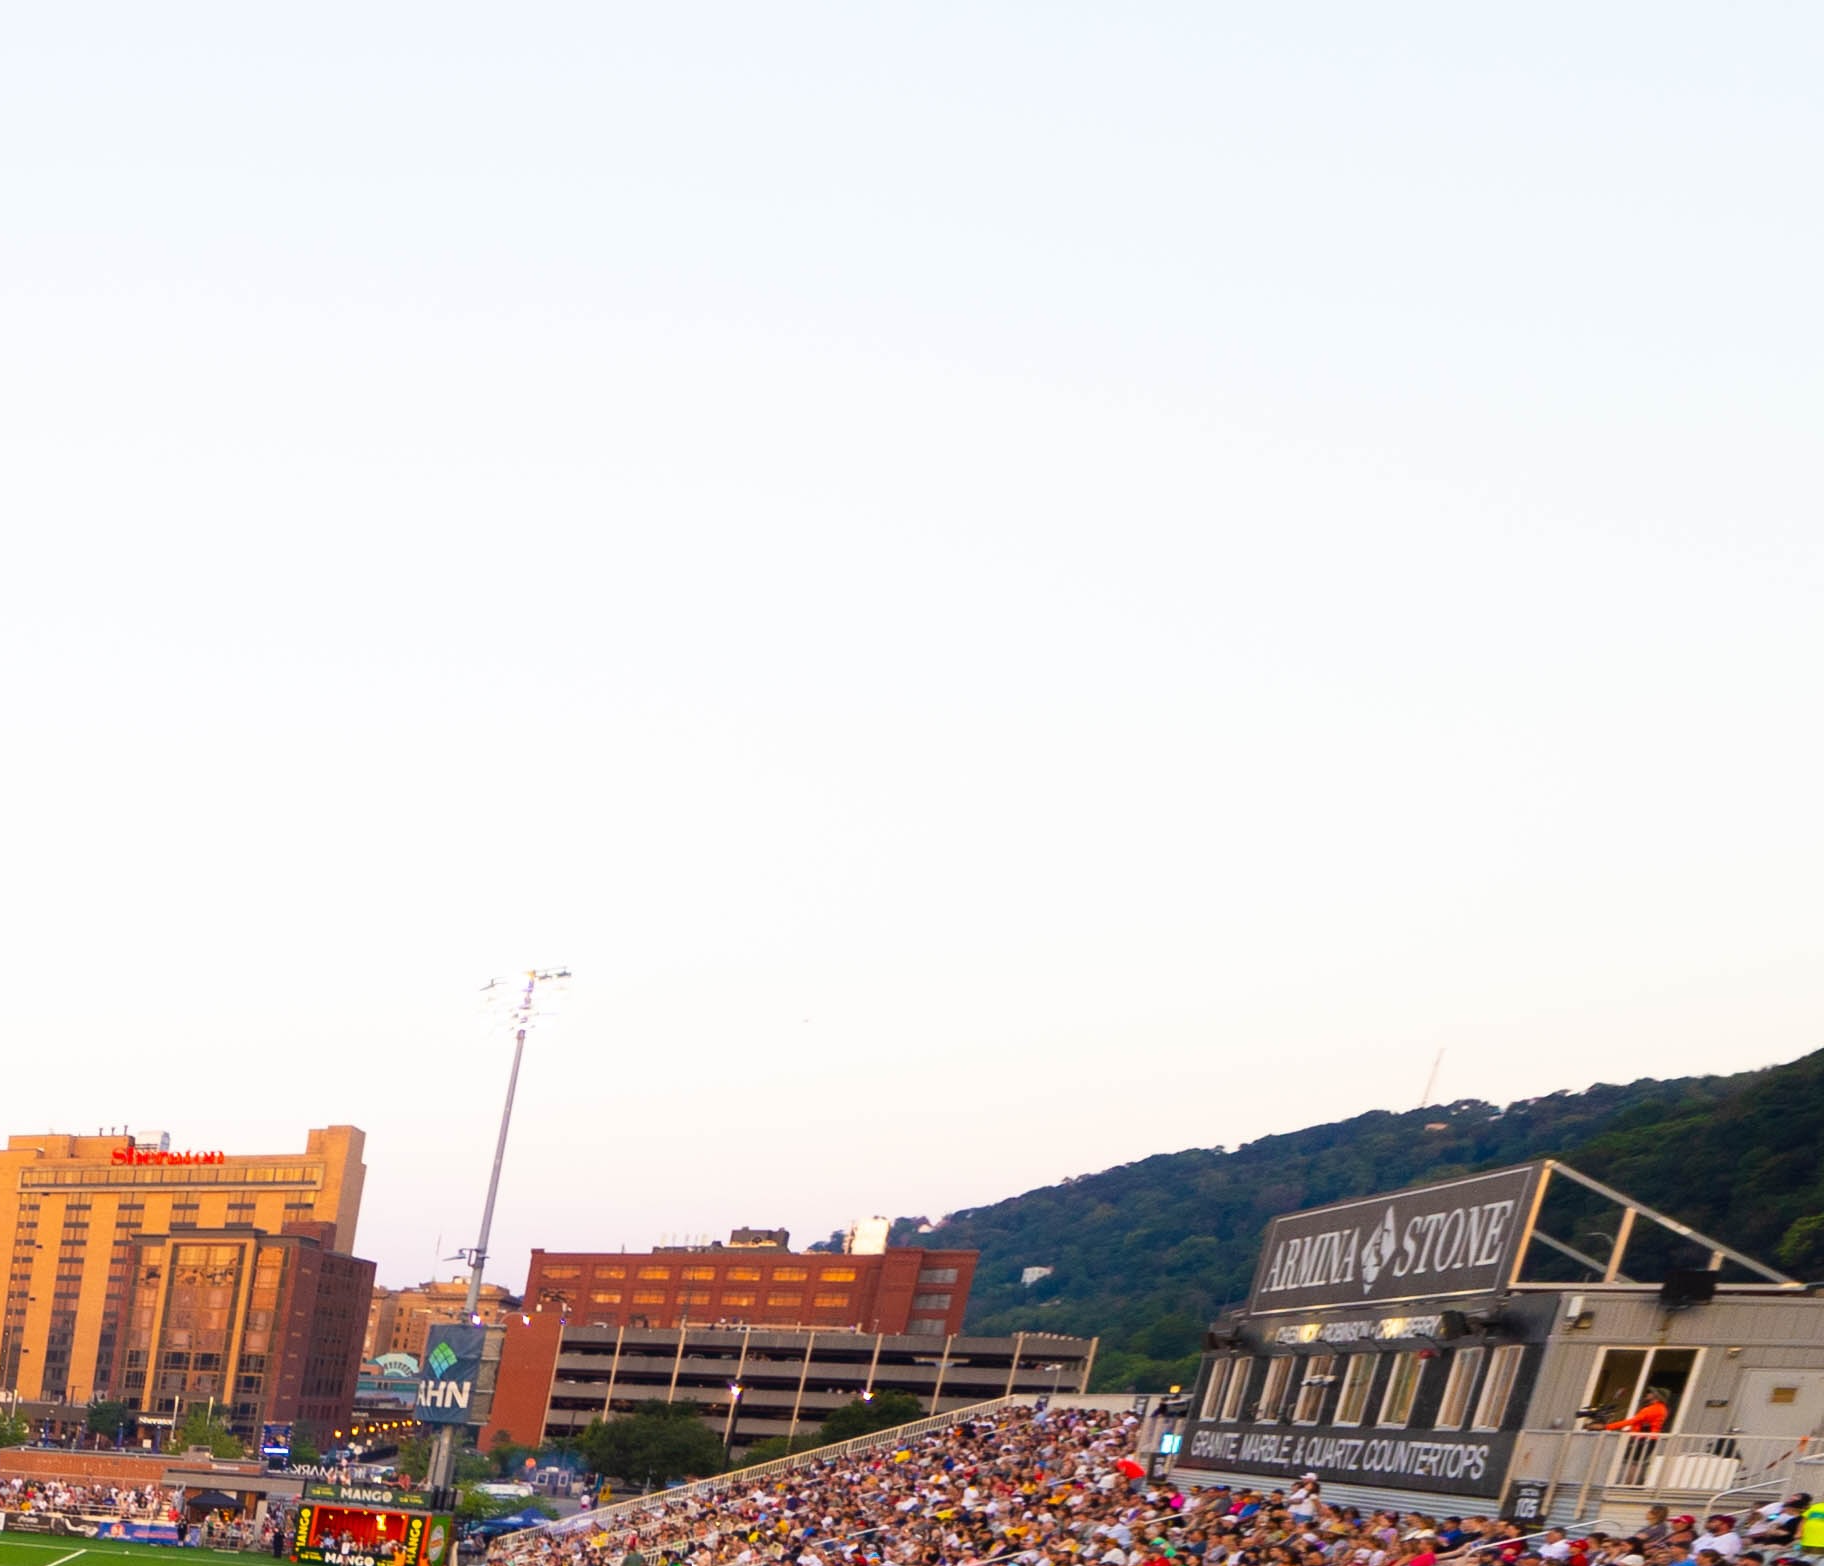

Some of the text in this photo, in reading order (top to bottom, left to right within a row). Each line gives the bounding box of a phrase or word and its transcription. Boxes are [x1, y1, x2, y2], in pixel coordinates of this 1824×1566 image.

[111, 1146, 225, 1167] Sheraton
[1260, 1199, 1514, 1294] ARMINA STONE
[416, 1379, 471, 1409] AHN
[1190, 1430, 1490, 1481] GRANITE, MARBLE, & QUARTZ COUNTERTOPS
[340, 1487, 393, 1503] MANGO
[405, 1518, 423, 1565] MANGO
